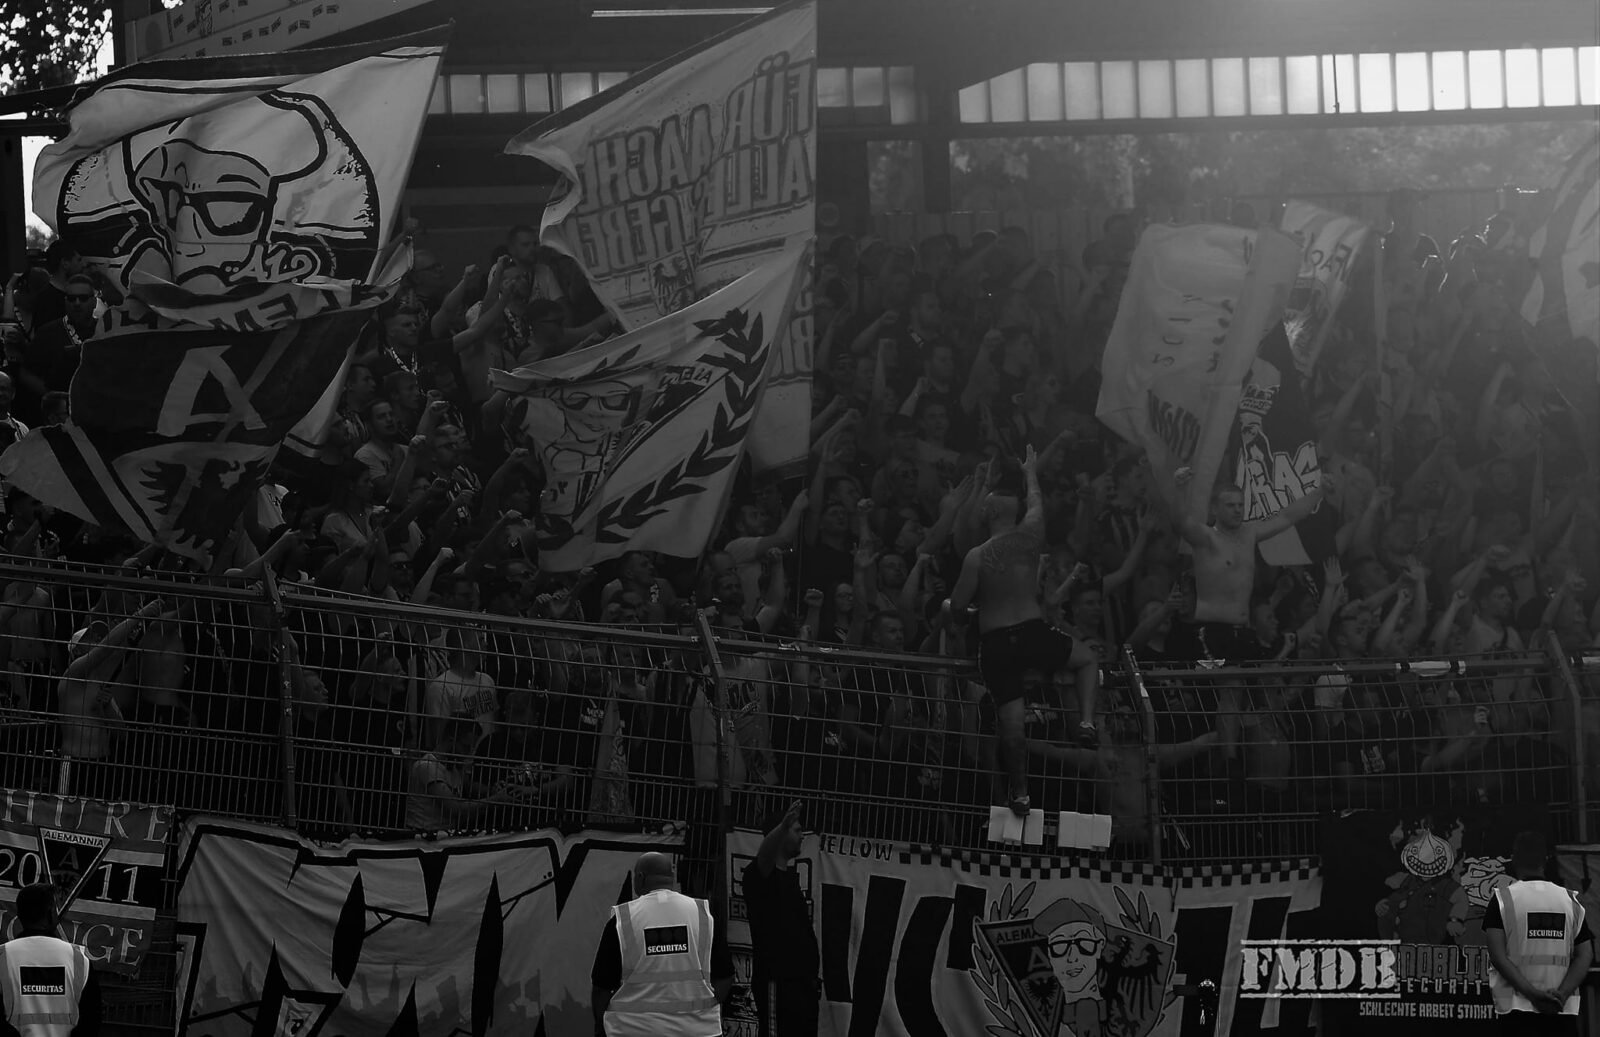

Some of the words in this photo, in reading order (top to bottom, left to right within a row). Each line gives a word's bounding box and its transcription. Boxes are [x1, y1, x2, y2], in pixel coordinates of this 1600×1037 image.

[44, 830, 104, 848] ALEMANNIA
[996, 927, 1037, 944] ALEM
[1528, 929, 1564, 938] SECURITAS
[647, 943, 687, 954] SECURITAS
[22, 984, 64, 993] SECURITAS
[1359, 1000, 1417, 1017] SCHLECHTE
[1419, 1002, 1455, 1019] ARBEIT
